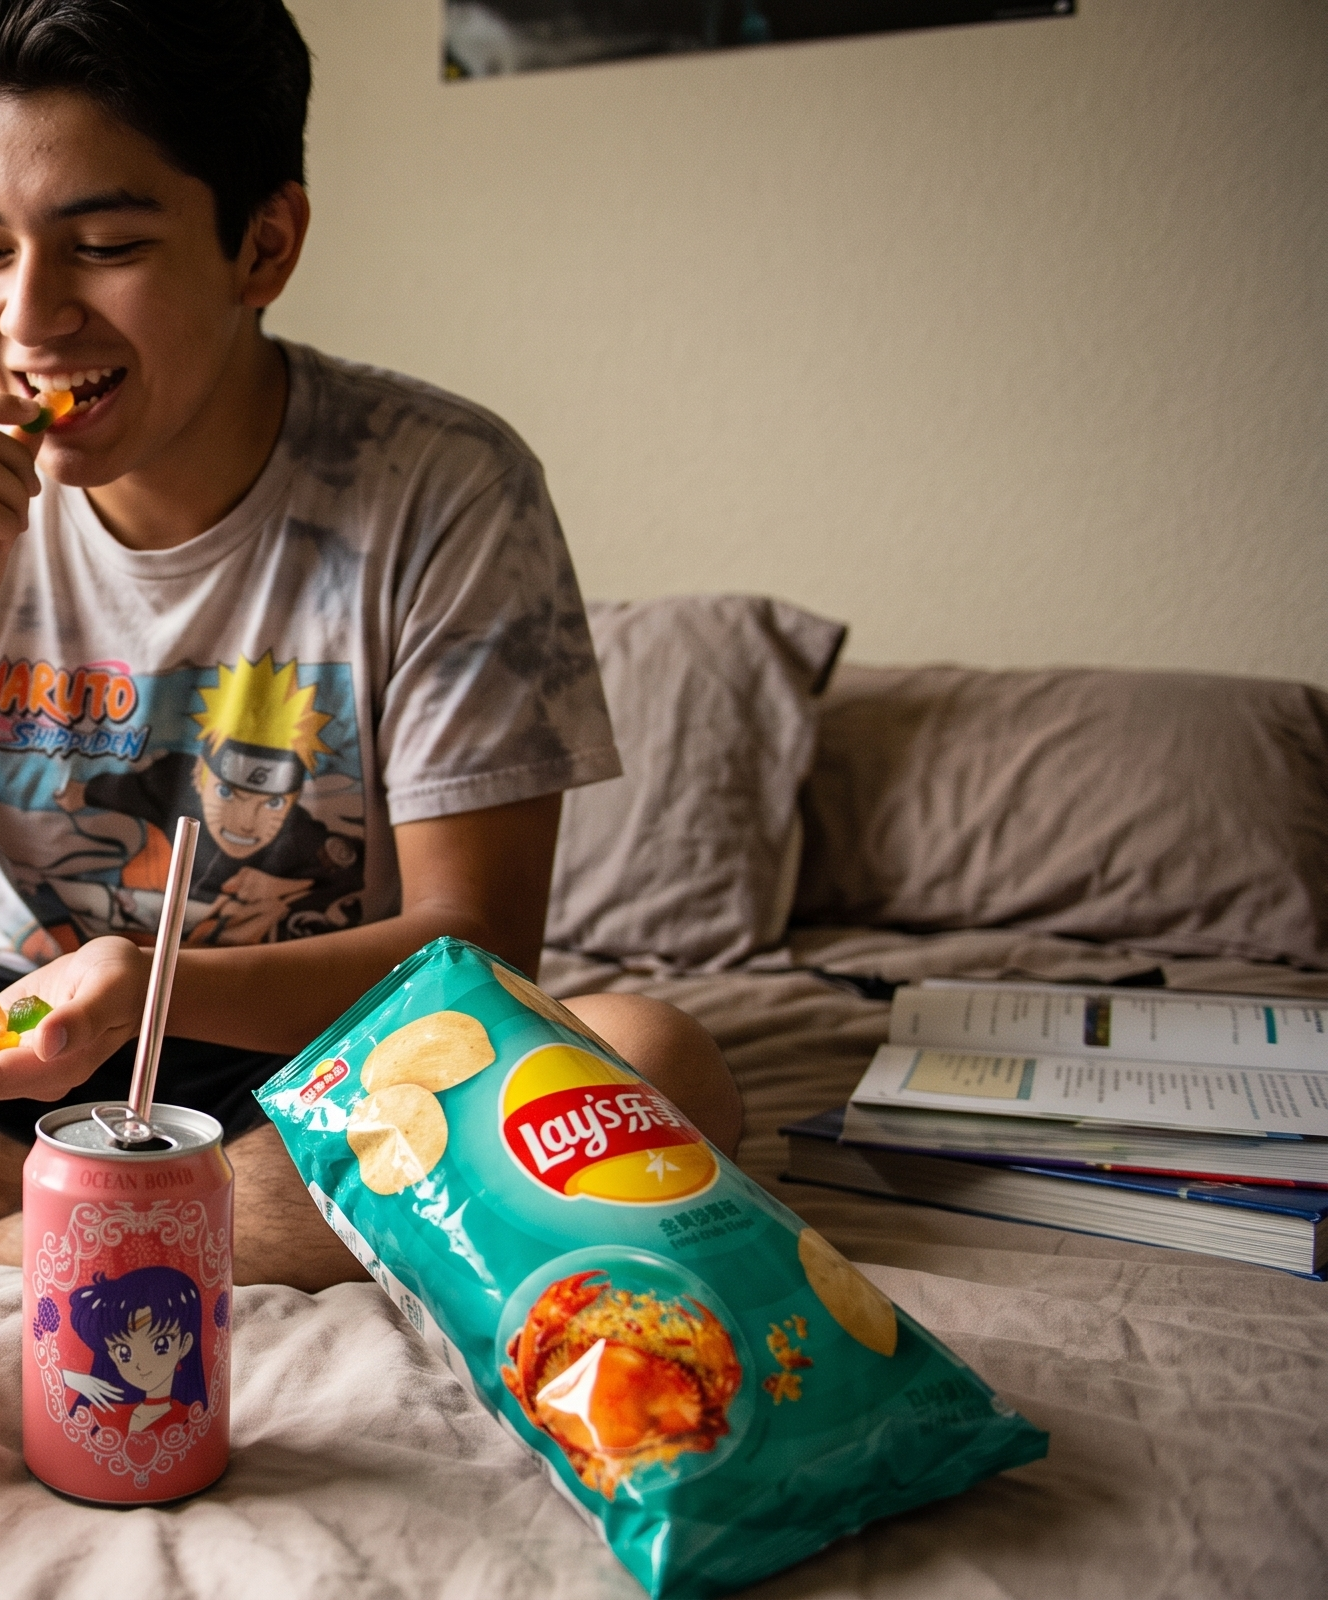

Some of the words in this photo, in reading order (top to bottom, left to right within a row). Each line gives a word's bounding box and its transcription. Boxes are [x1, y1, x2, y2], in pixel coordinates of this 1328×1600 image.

[0, 721, 150, 762] SHIPPUDEN
[518, 1094, 622, 1174] Lay's
[80, 1169, 137, 1190] OCEAN
[145, 1167, 195, 1190] BOMB
